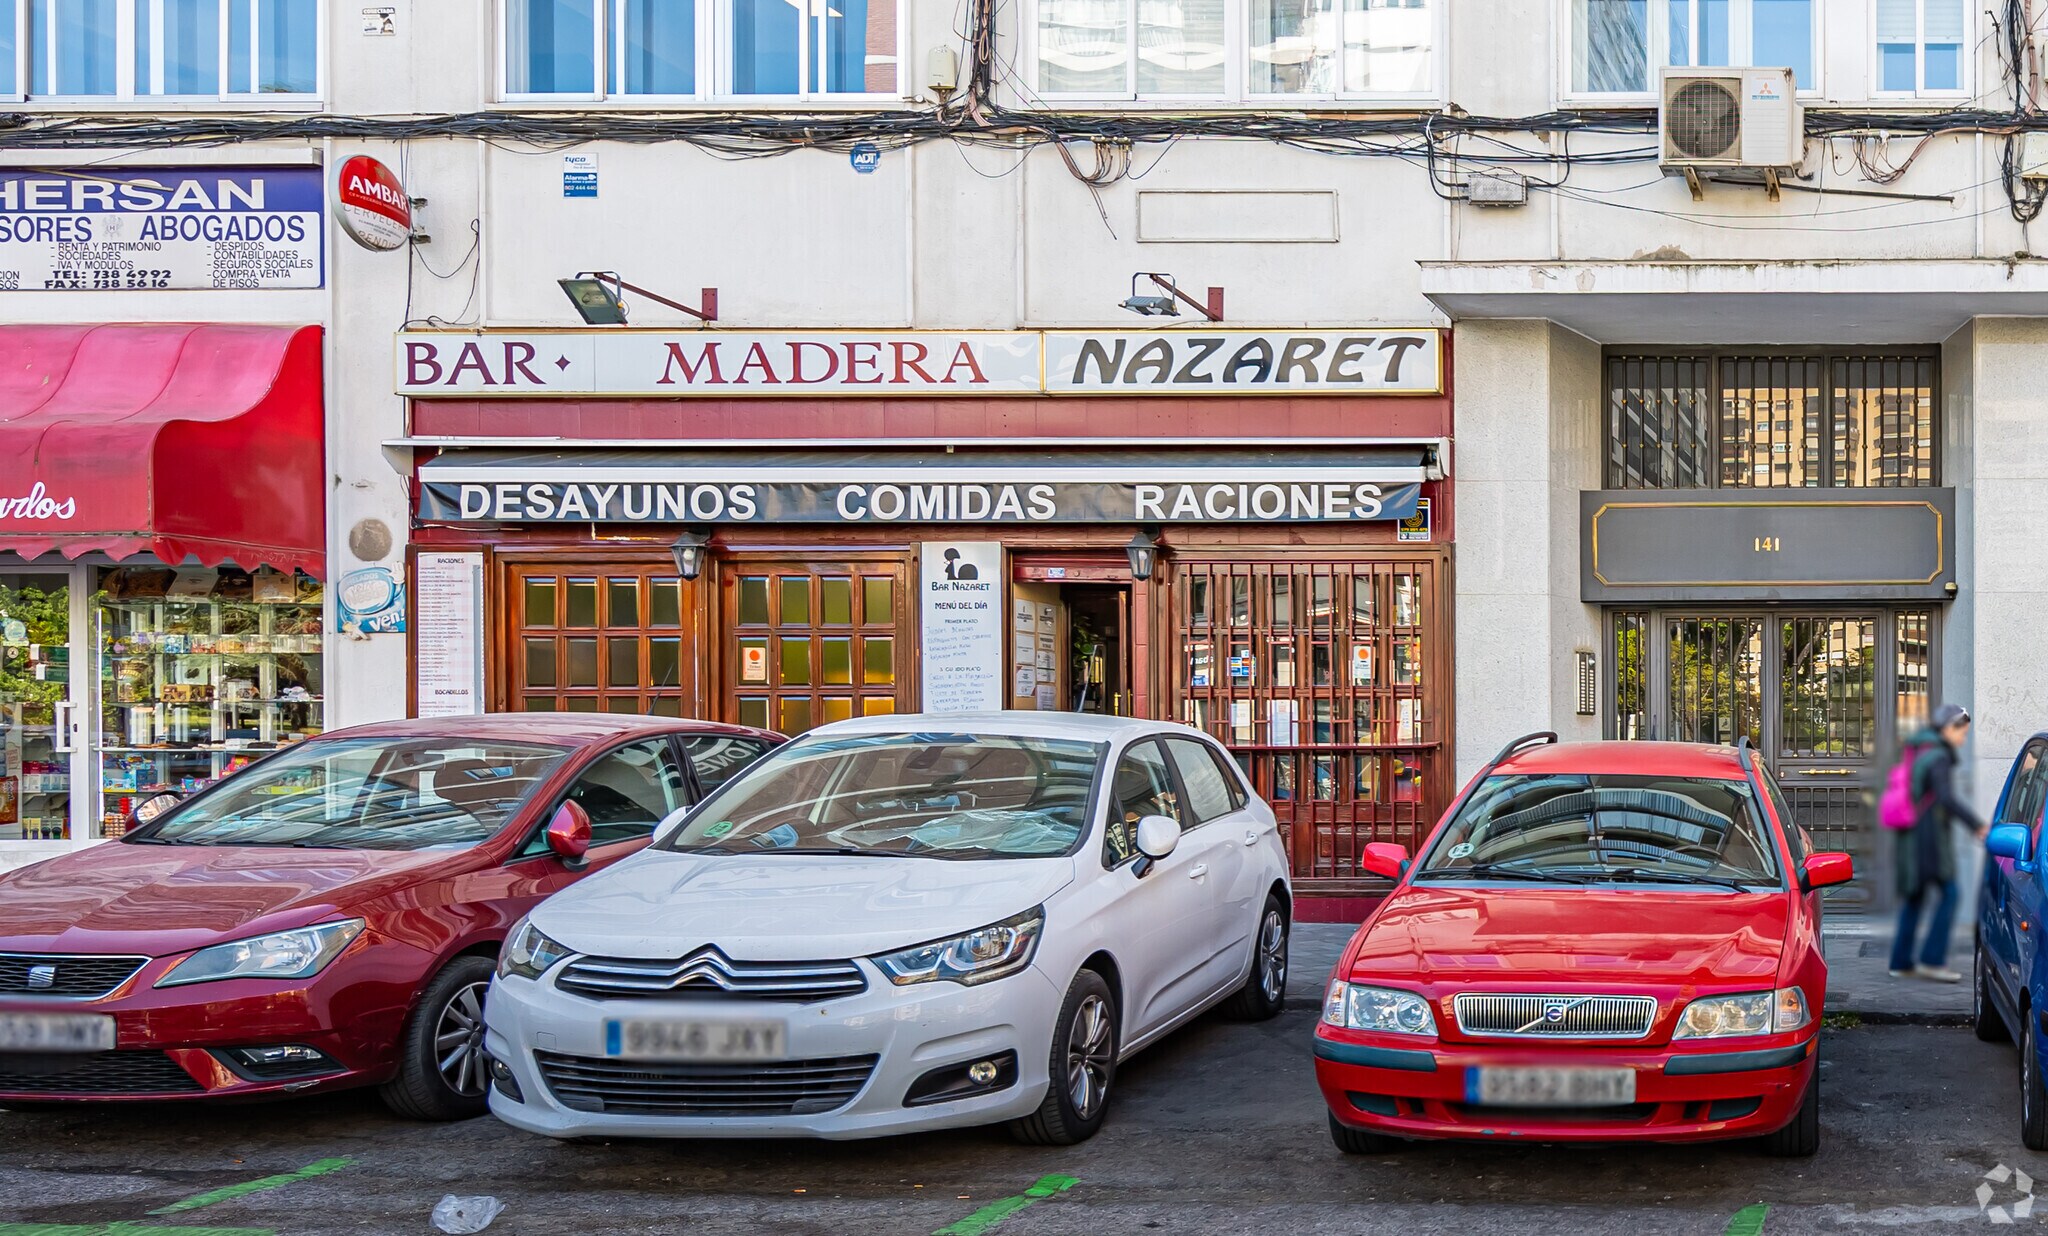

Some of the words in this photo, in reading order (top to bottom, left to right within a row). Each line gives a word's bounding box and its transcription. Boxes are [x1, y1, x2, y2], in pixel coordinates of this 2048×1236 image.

[855, 153, 876, 164] ADT
[349, 174, 408, 214] AMBAR
[139, 215, 305, 242] ABOGADOS
[58, 242, 89, 251] RENTA
[93, 242, 98, 251] Y
[102, 242, 162, 251] PATRIMONIO
[214, 242, 264, 251] DESPIDOS
[58, 251, 121, 261] SOCIEDADES
[213, 251, 298, 260] CONTABILIDADES
[58, 261, 72, 270] IVA
[76, 261, 82, 269] Y
[84, 261, 134, 270] MODULOS
[213, 260, 262, 268] SEGUROS
[264, 260, 313, 268] SOCIALES
[52, 270, 86, 279] TEL:
[93, 270, 120, 279] 738
[126, 270, 171, 279] 4992
[44, 280, 86, 289] FAX:
[93, 280, 120, 288] 738
[213, 279, 226, 288] DE
[229, 279, 259, 288] PISOS
[405, 341, 547, 386] BAR
[656, 341, 989, 385] MADERA
[1072, 336, 1427, 384] NAZARET
[459, 483, 758, 521] DESAYUNOS
[836, 483, 1057, 522] COMIDAS
[1135, 483, 1383, 520] RACIONES
[1754, 537, 1780, 552] 141
[934, 600, 957, 610] MENÚ
[958, 602, 972, 610] DEL
[974, 600, 988, 610] DÍA
